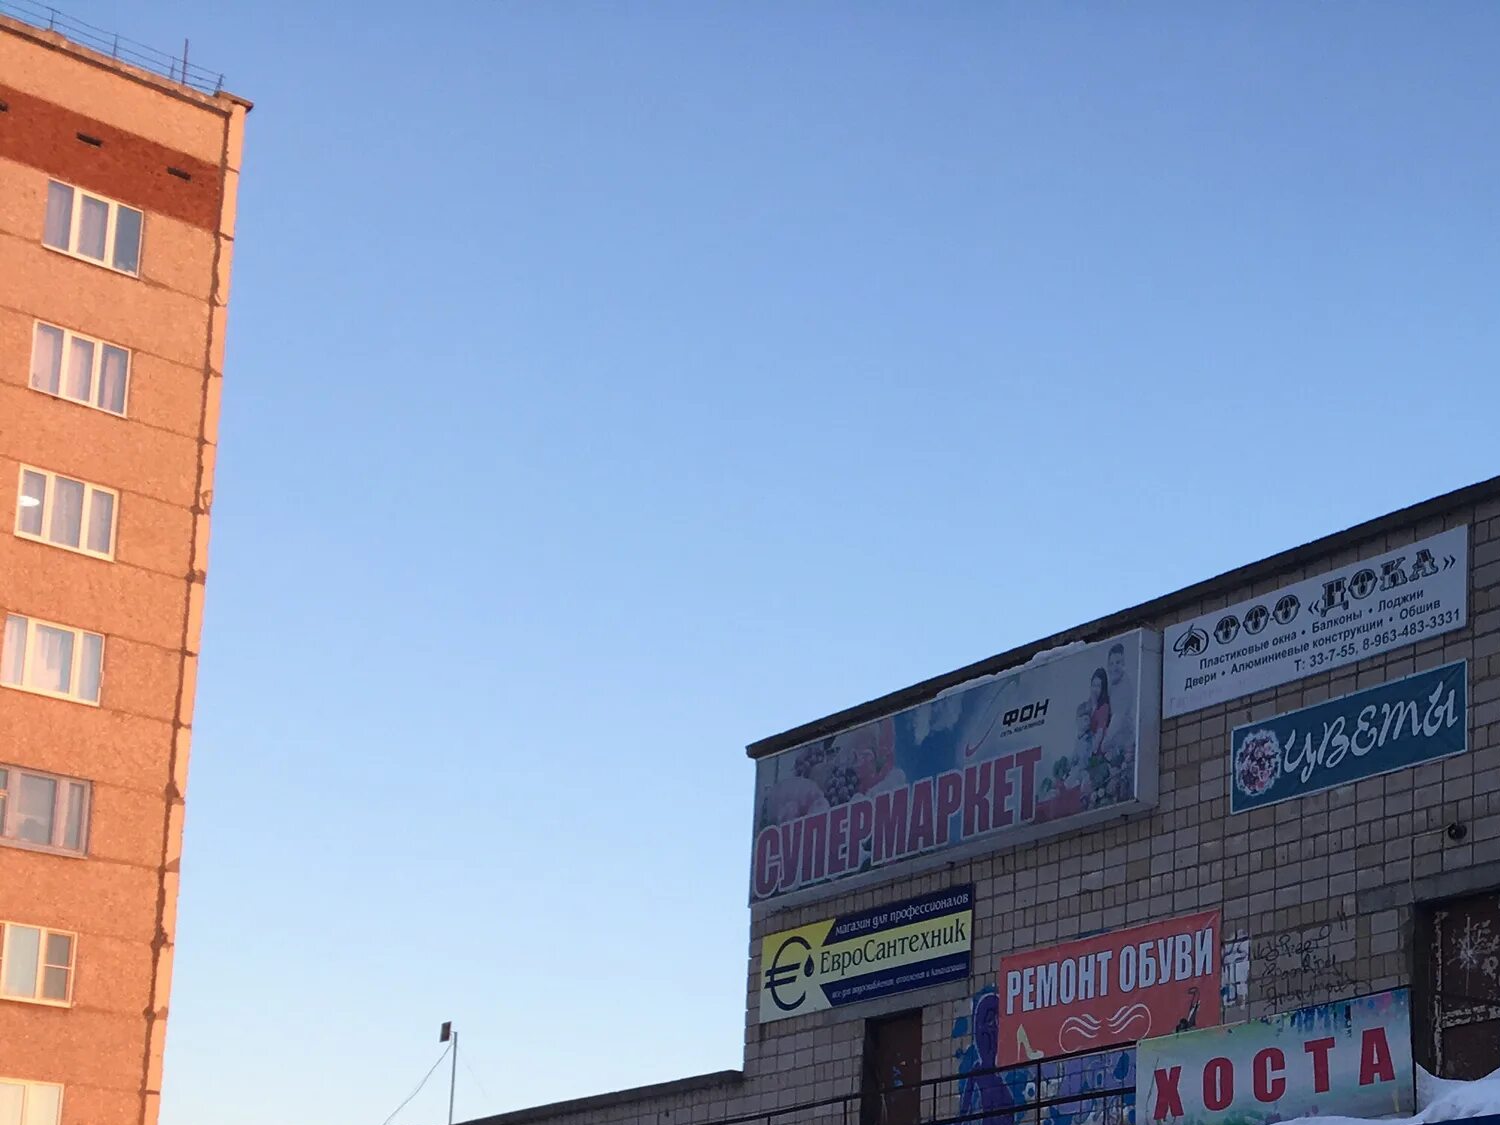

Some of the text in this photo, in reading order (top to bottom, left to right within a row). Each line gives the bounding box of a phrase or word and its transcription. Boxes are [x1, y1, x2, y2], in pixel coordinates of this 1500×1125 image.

[1184, 599, 1441, 691] Двери Алюминиевые конструкции Обшив
[1200, 589, 1424, 670] Пластиковые окна Балконы Лоджии
[1362, 608, 1460, 651] 8-963-483-3331
[1002, 698, 1049, 728] ФОН
[755, 746, 1043, 898] СУПЕРМАРКЕТ
[820, 918, 966, 980] ЕвроСантехник
[835, 893, 969, 936] магазин для профессионалов
[1006, 949, 1112, 1015] РЕМОНТ
[1119, 927, 1213, 991] ОБУВИ
[1153, 1026, 1395, 1121] ХОСТА
